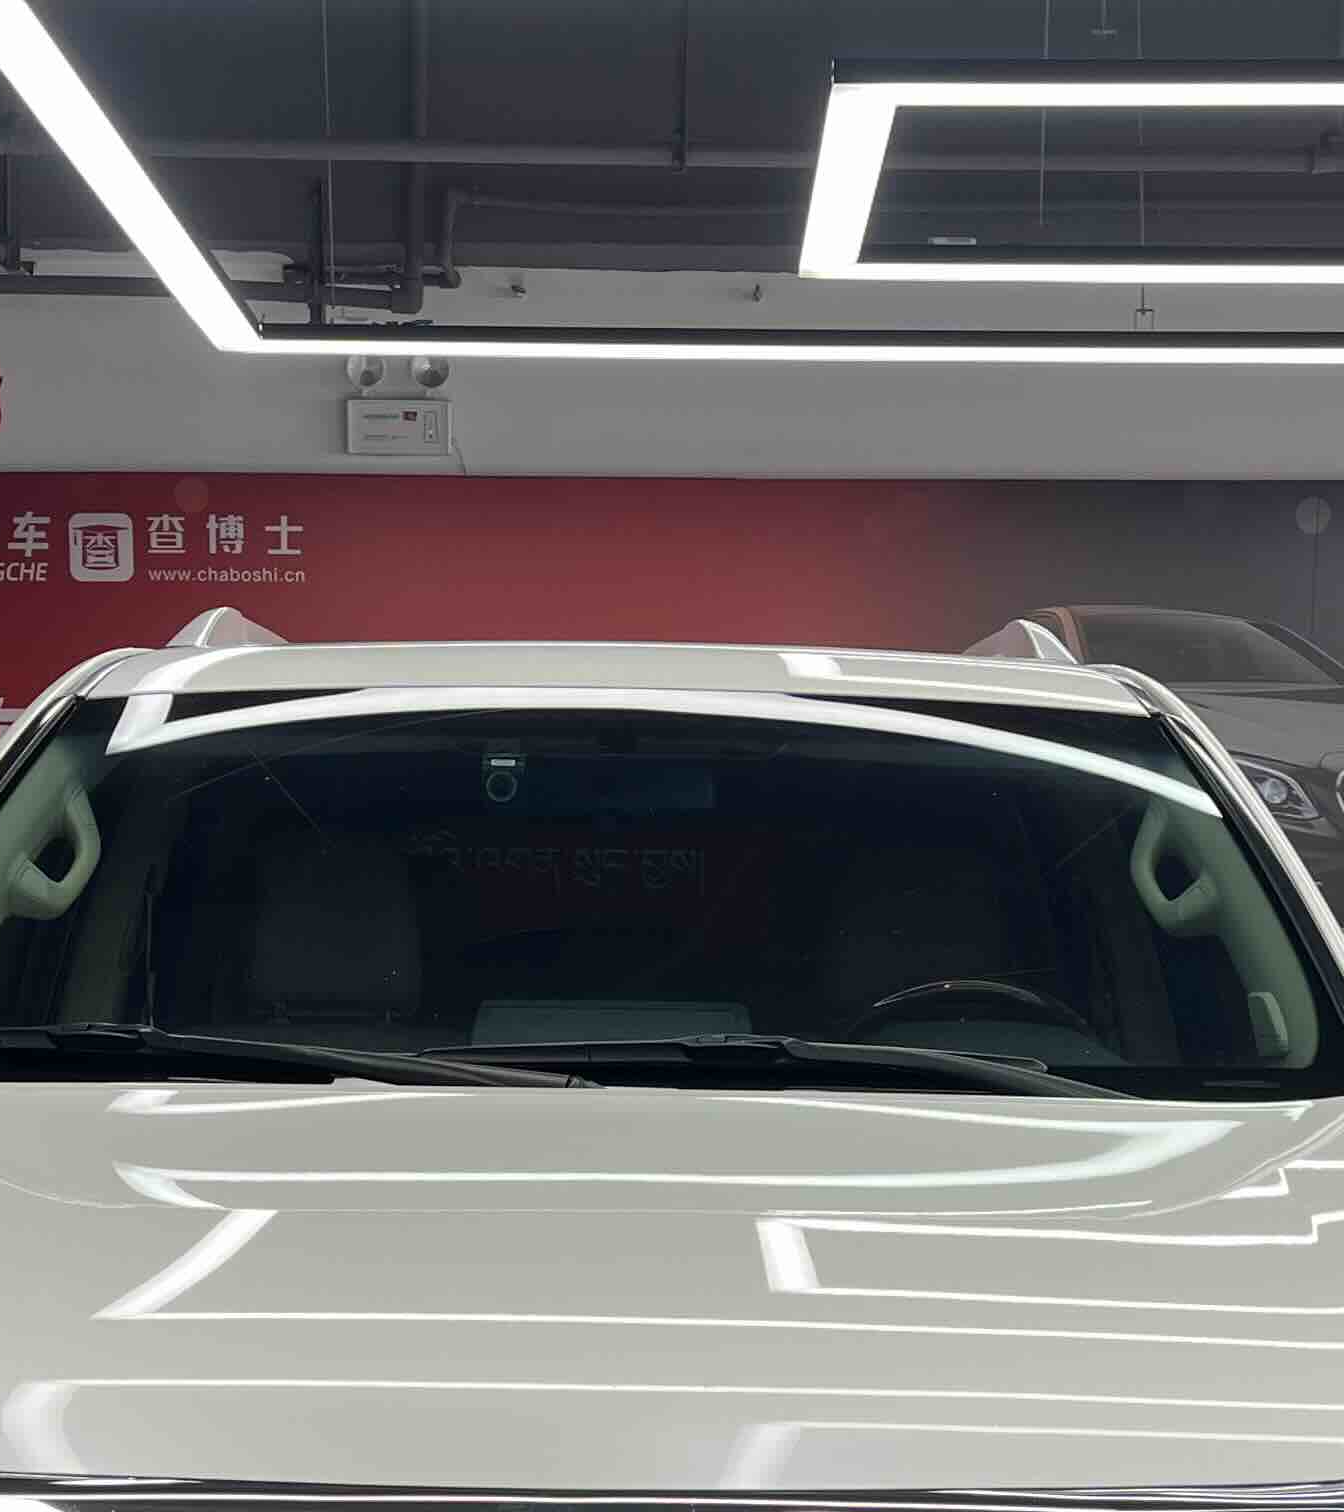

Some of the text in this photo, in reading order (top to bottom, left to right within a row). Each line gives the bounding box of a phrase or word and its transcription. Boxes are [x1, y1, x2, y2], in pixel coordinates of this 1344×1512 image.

[146, 513, 305, 556] 查博士
[147, 565, 306, 584] www.chaboshi.cn
